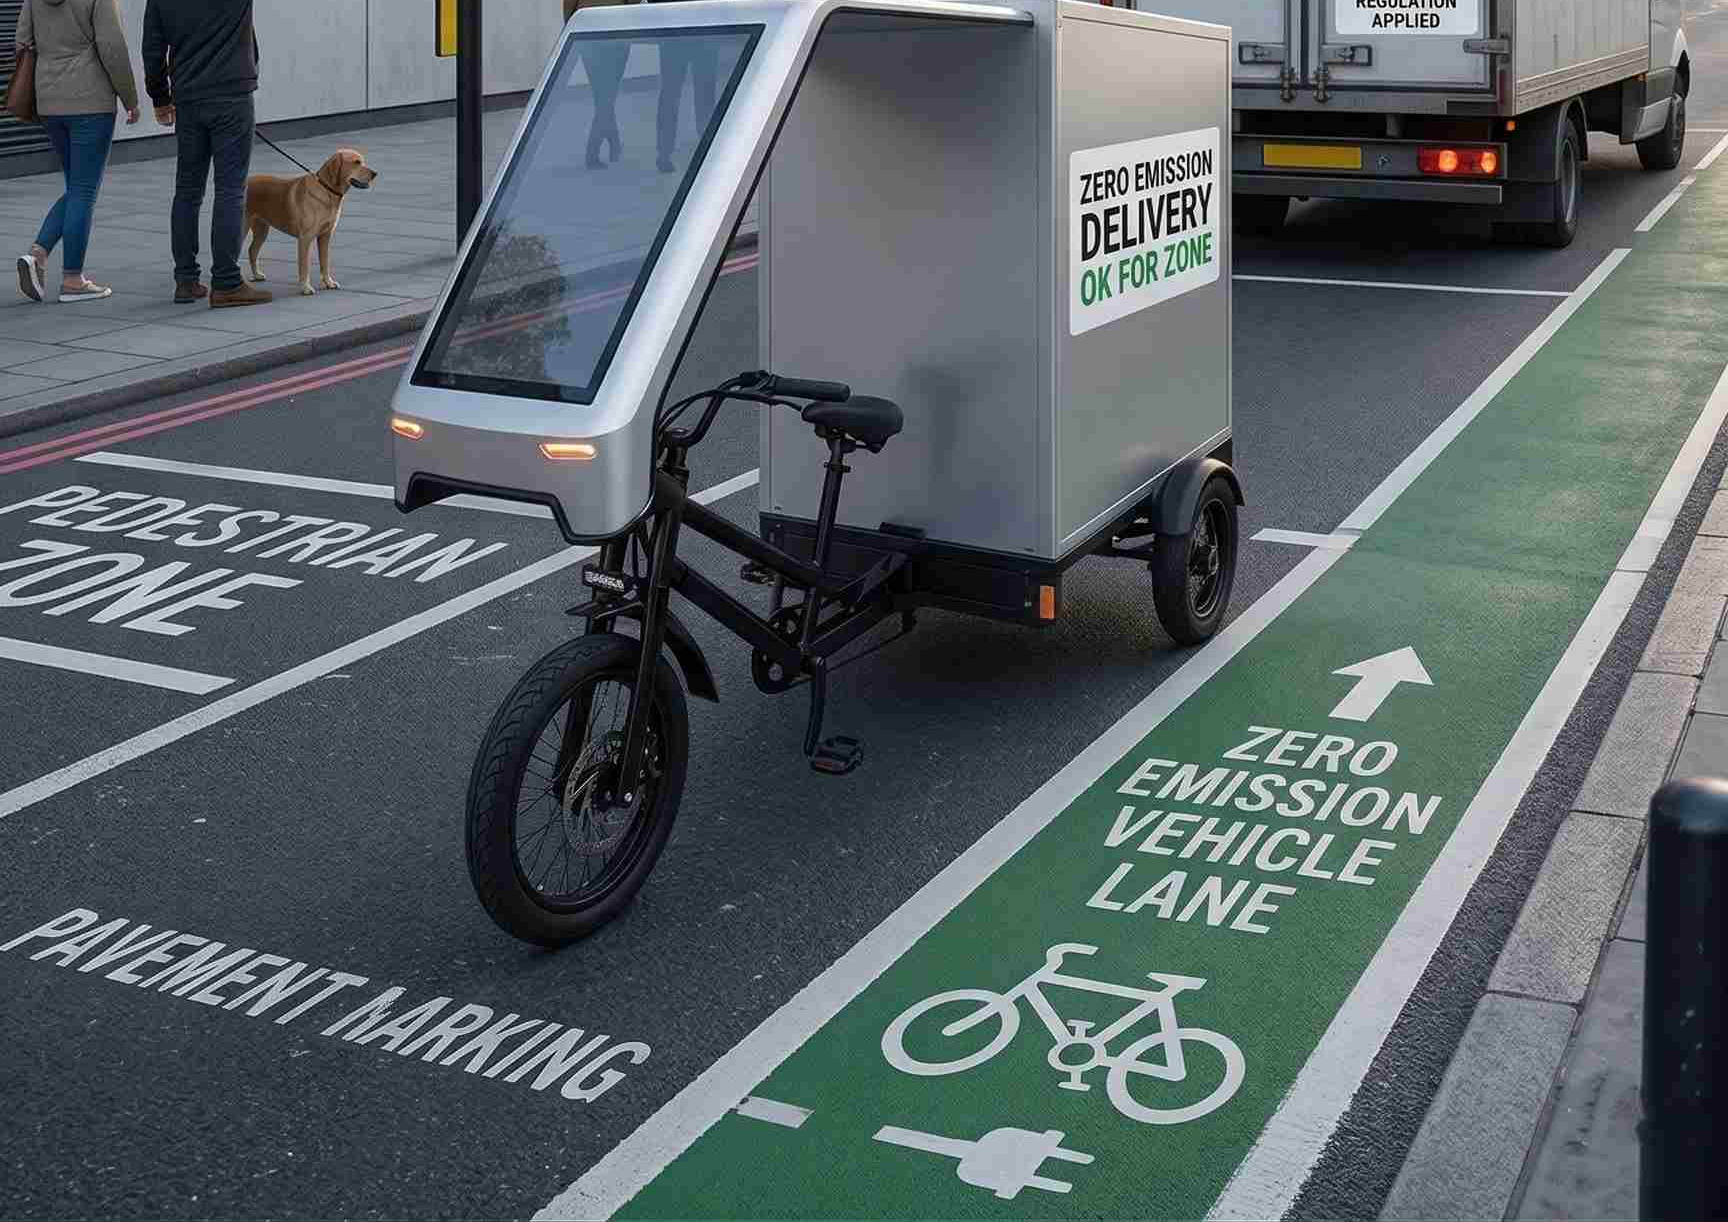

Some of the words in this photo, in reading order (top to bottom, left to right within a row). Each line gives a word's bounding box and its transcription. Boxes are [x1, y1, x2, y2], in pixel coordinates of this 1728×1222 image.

[1371, 13, 1440, 28] APPLIED
[1080, 166, 1129, 205] ZERO
[1135, 148, 1212, 192] EMISSION
[1081, 182, 1212, 262] DELIVERY
[1081, 264, 1112, 306] OK
[1119, 251, 1158, 294] FOR
[1164, 232, 1212, 278] ZONE
[0, 485, 509, 583] PEDESTRIAN
[1223, 725, 1398, 777] ZERO
[1116, 758, 1442, 835] EMISSION
[1104, 806, 1396, 886] VEHICLE
[1086, 862, 1296, 935] LANE
[0, 908, 369, 1025] PAVEMENT
